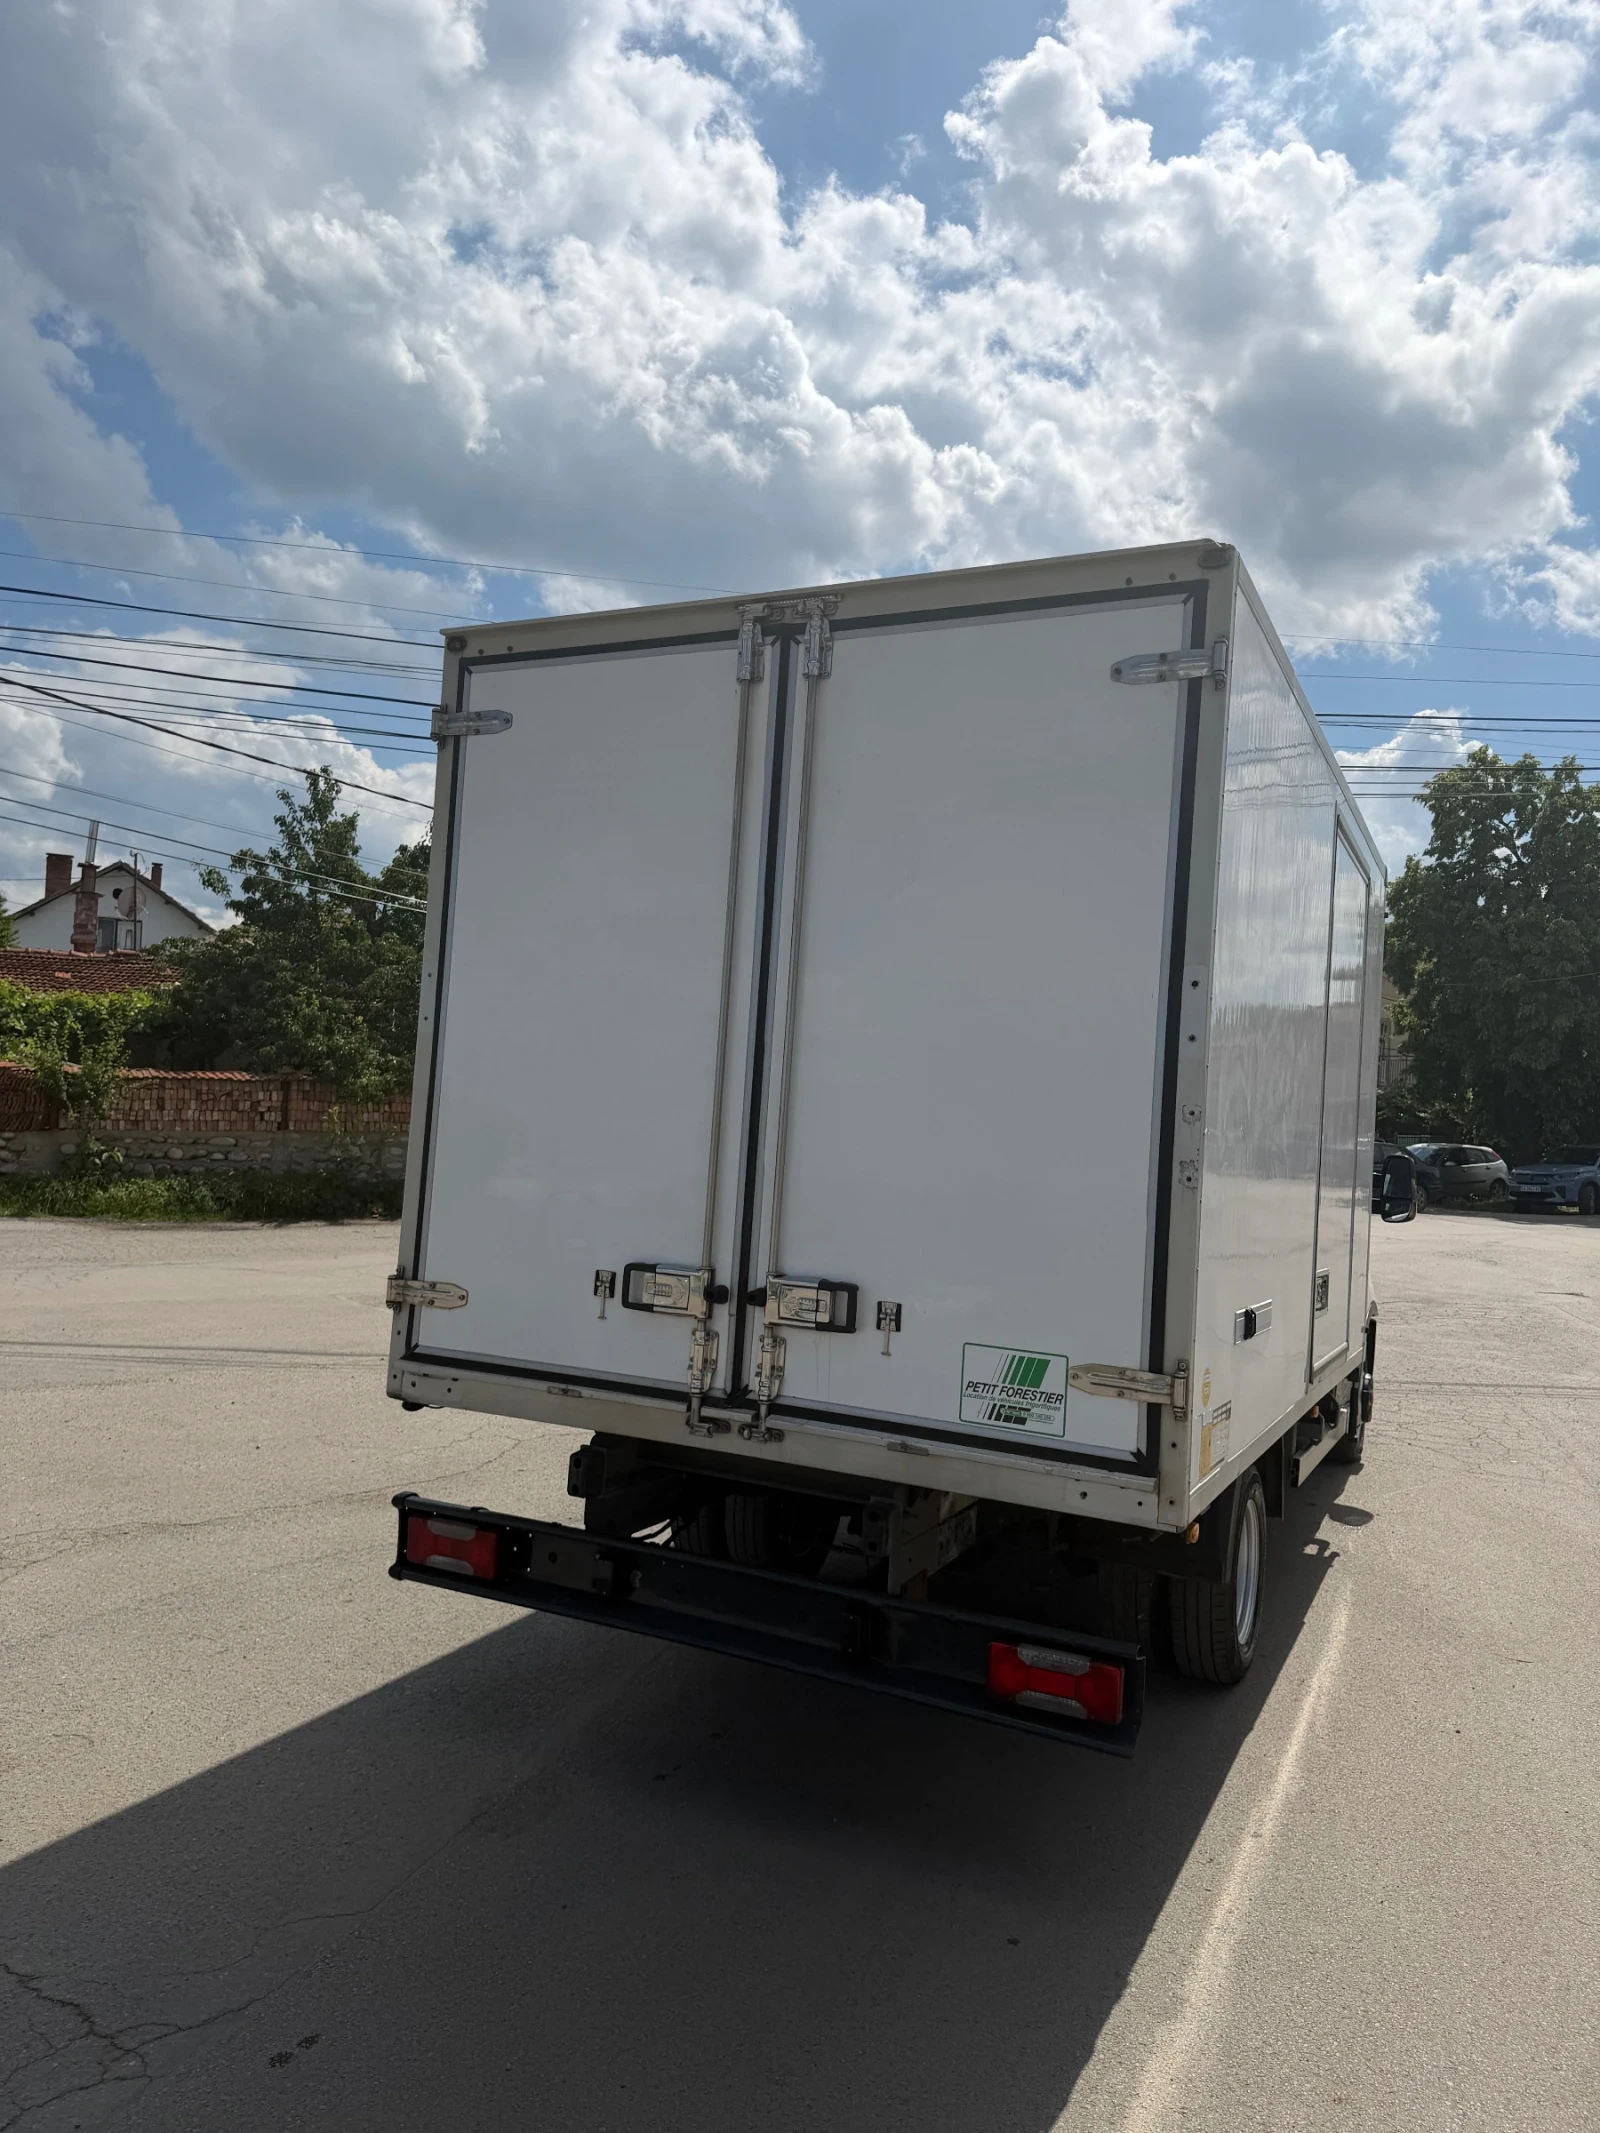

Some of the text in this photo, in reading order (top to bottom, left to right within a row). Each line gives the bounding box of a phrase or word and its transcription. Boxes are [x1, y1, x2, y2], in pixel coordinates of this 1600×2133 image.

[963, 1392, 988, 1401] Location
[965, 1381, 1064, 1405] PETIT FORESTIER
